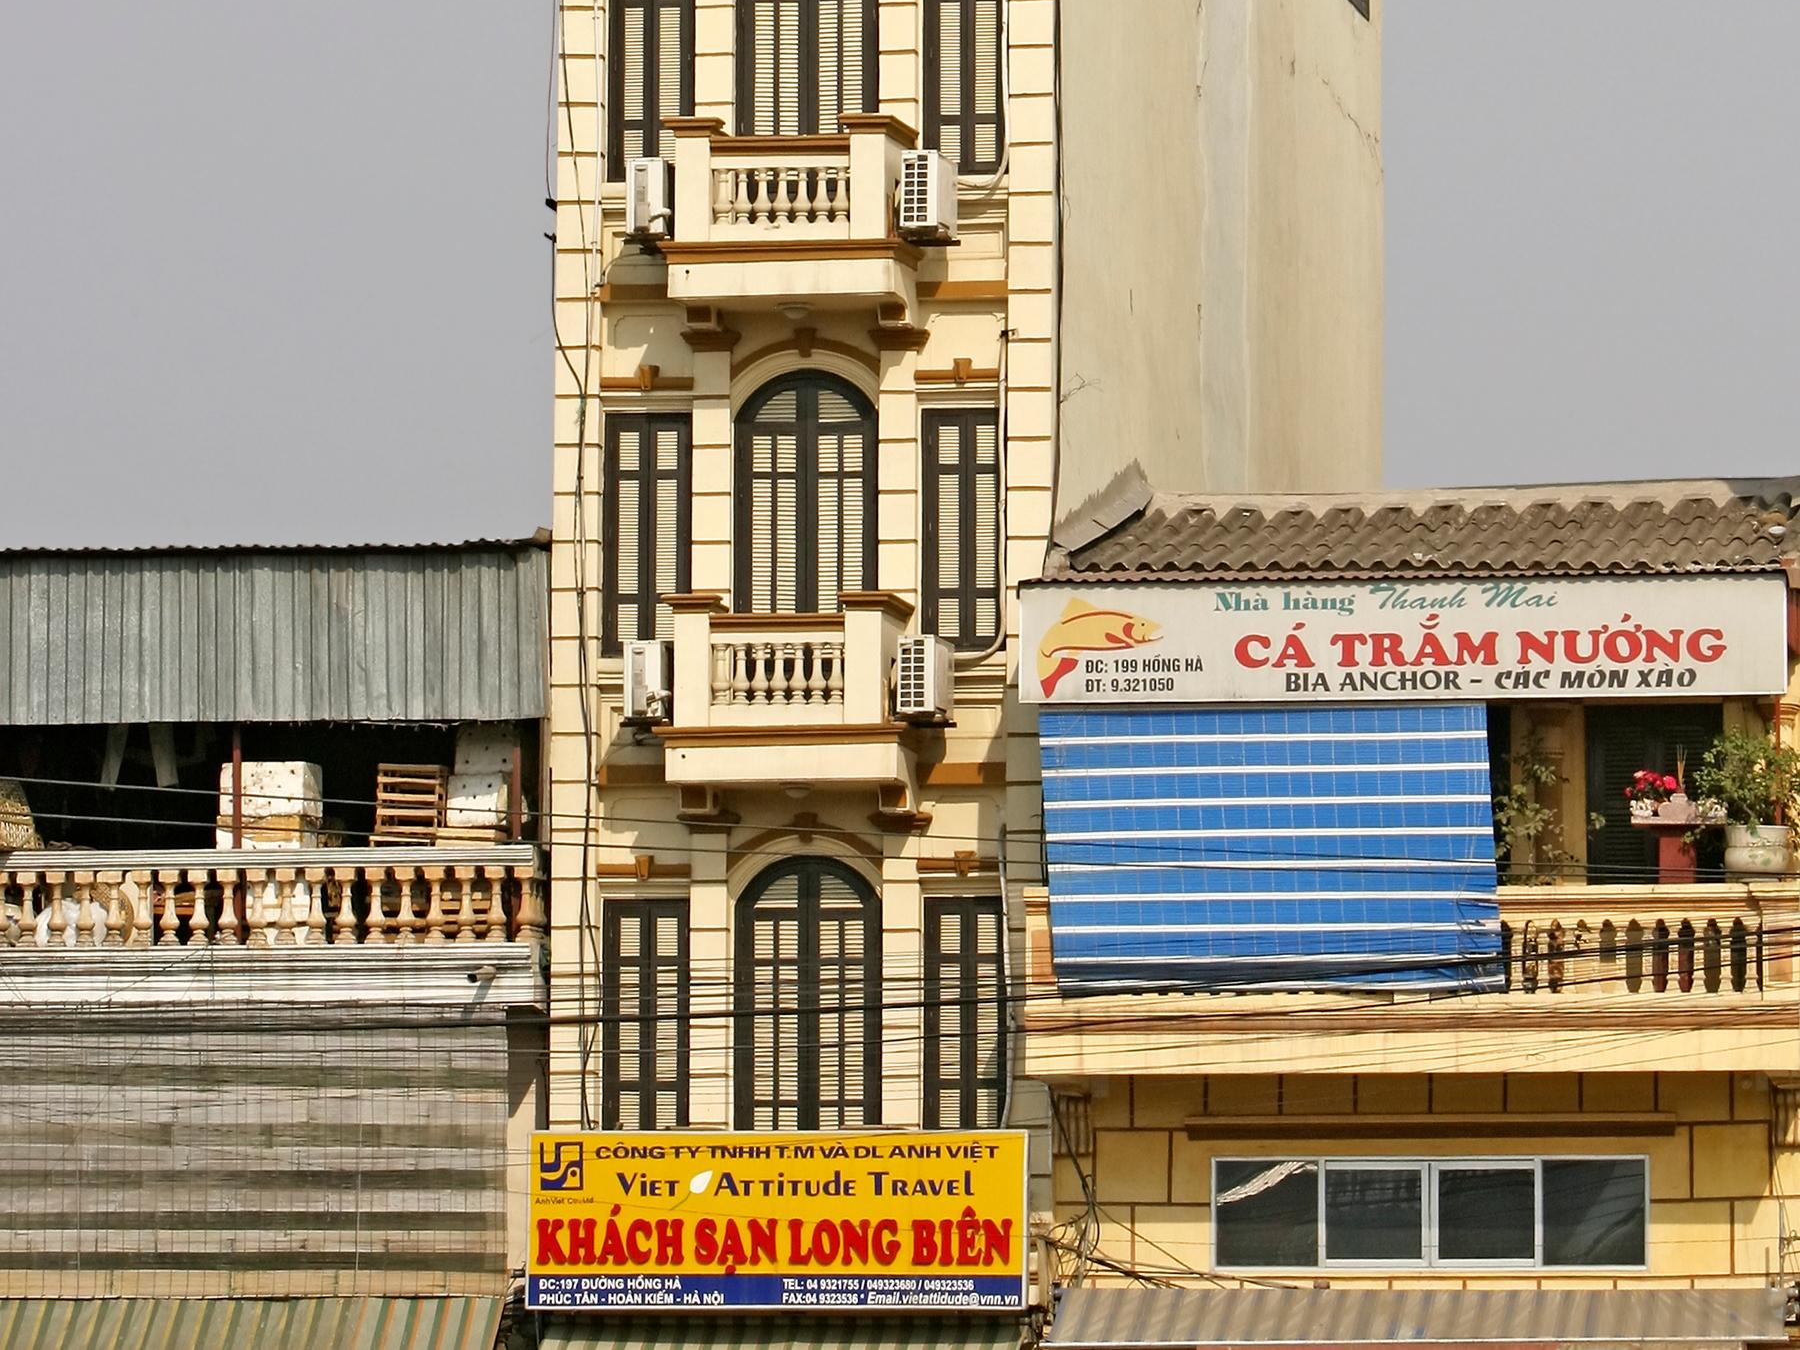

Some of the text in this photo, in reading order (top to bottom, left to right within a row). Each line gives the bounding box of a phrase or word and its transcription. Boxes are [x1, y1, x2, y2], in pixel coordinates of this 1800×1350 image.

[1213, 583, 1559, 617] Nhà hàng Thanh Mai
[1234, 613, 1728, 669] CÁ TRẮM NƯỚNG
[1085, 659, 1108, 673] ĐC:
[1113, 659, 1138, 673] 199
[1185, 654, 1204, 672] HÀ
[1085, 677, 1174, 693] ĐT: 9.321050
[1285, 672, 1331, 692] BIA
[1339, 669, 1463, 692] ANCHOR
[1494, 666, 1552, 690] CÁC
[1559, 665, 1629, 689] MÓN
[1635, 663, 1698, 689] XÀO
[595, 1142, 666, 1159] CÔNG
[668, 1145, 702, 1159] TY
[706, 1145, 771, 1159] TNHH
[819, 1141, 850, 1159] VÀ
[854, 1145, 884, 1159] DL
[889, 1145, 942, 1159] ANH
[946, 1141, 1000, 1163] VIỆT
[536, 1203, 1013, 1275] KHÁCH SẠN LONG BIÊN
[538, 1274, 682, 1290] ĐC:197 ĐƯỜNG HỒNG HÀ
[782, 1278, 804, 1290] TEL:
[806, 1278, 818, 1290] 04
[820, 1278, 860, 1290] 9321755
[867, 1278, 917, 1291] 049323680
[923, 1279, 975, 1291] 049323536
[538, 1290, 572, 1305] PHÚC
[574, 1290, 599, 1305] TÂN
[608, 1290, 643, 1305] HOÀN
[644, 1289, 674, 1304] KIẾM
[683, 1289, 701, 1305] HÀ
[703, 1290, 724, 1306] NỘI
[819, 1292, 859, 1304] 9323536
